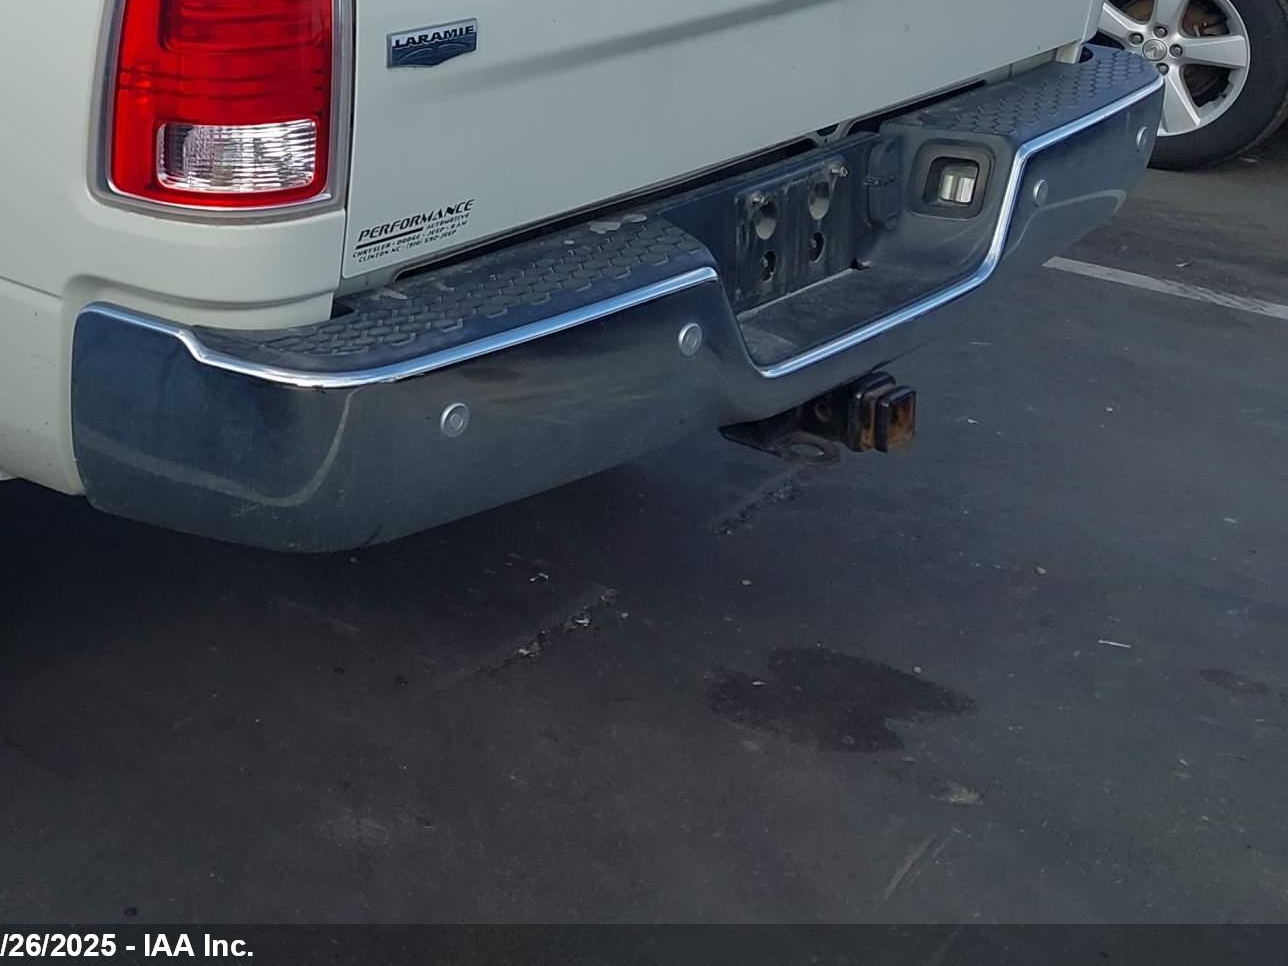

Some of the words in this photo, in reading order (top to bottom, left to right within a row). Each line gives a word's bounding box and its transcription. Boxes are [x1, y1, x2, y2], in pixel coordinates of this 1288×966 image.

[394, 25, 475, 48] LARAMIE
[357, 199, 475, 243] PERFORMANCE
[425, 213, 470, 231] AUTOMOTIVE
[352, 242, 392, 259] CHRYSLER
[396, 234, 420, 246] DODGE
[427, 226, 447, 237] JEEP
[450, 220, 468, 231] RAM
[358, 249, 390, 263] CLINTON
[391, 245, 402, 254] NC
